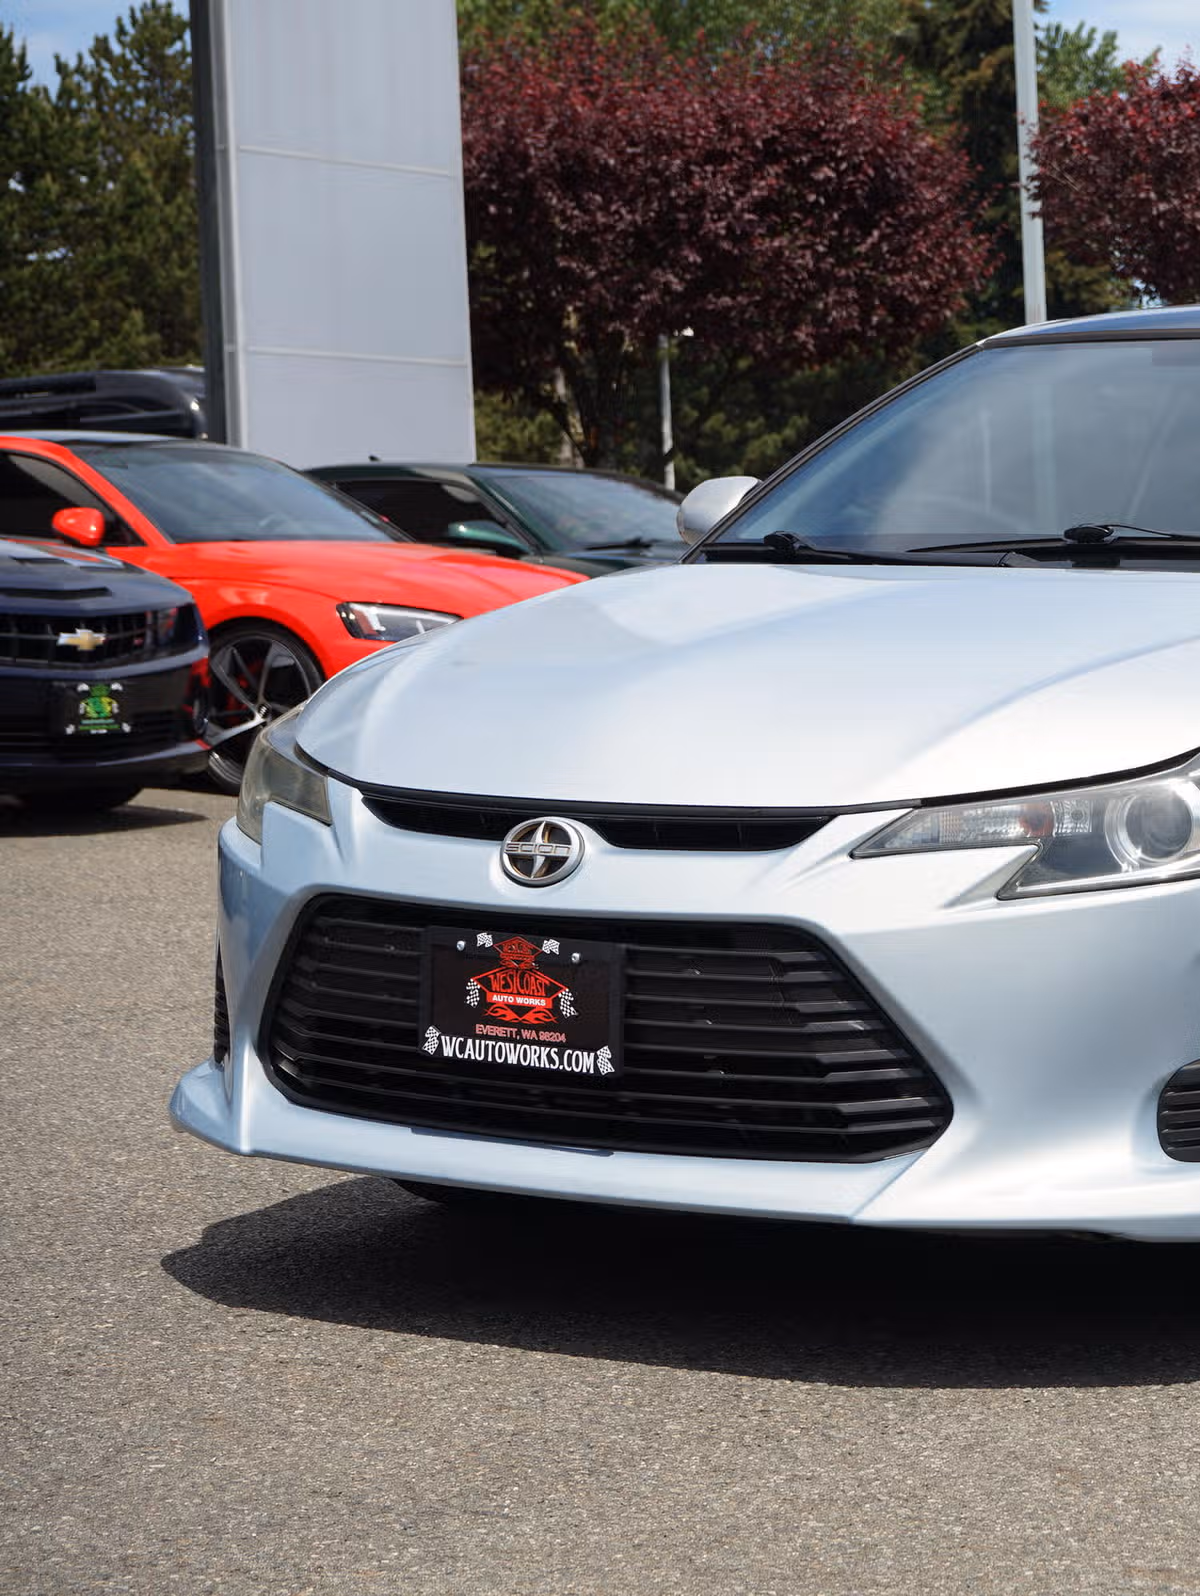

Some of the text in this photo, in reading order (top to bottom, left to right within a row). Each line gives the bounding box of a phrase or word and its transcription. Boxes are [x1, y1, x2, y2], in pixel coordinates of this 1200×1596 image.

[504, 842, 571, 856] SCION
[492, 994, 546, 1006] AUTO WORKS
[475, 1023, 519, 1040] EVERETT,
[521, 1028, 538, 1041] WA
[441, 1035, 595, 1074] WCAUTOWORKS.COM
